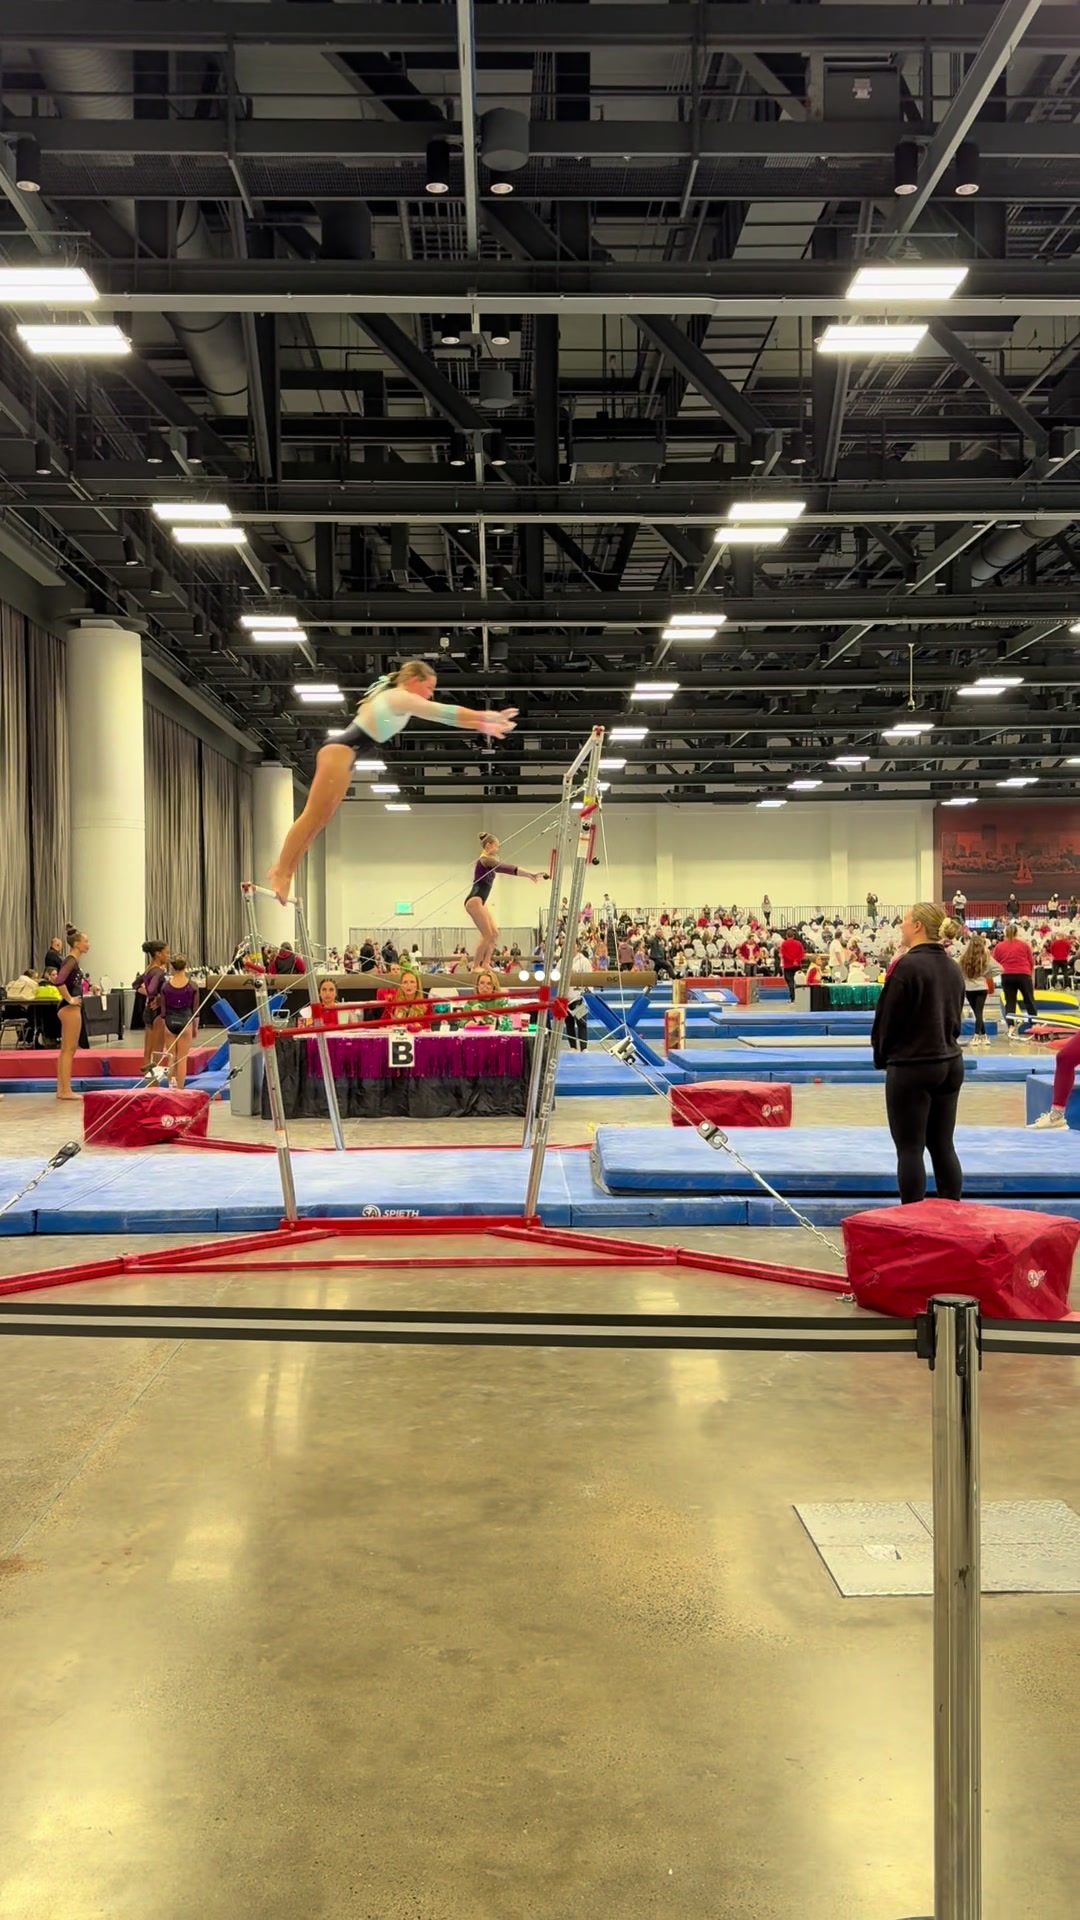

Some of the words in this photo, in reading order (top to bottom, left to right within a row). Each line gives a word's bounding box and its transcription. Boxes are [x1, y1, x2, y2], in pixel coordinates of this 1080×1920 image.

[392, 1041, 414, 1065] B
[536, 1058, 557, 1144] SPIETH
[383, 1209, 420, 1217] SPIETH
